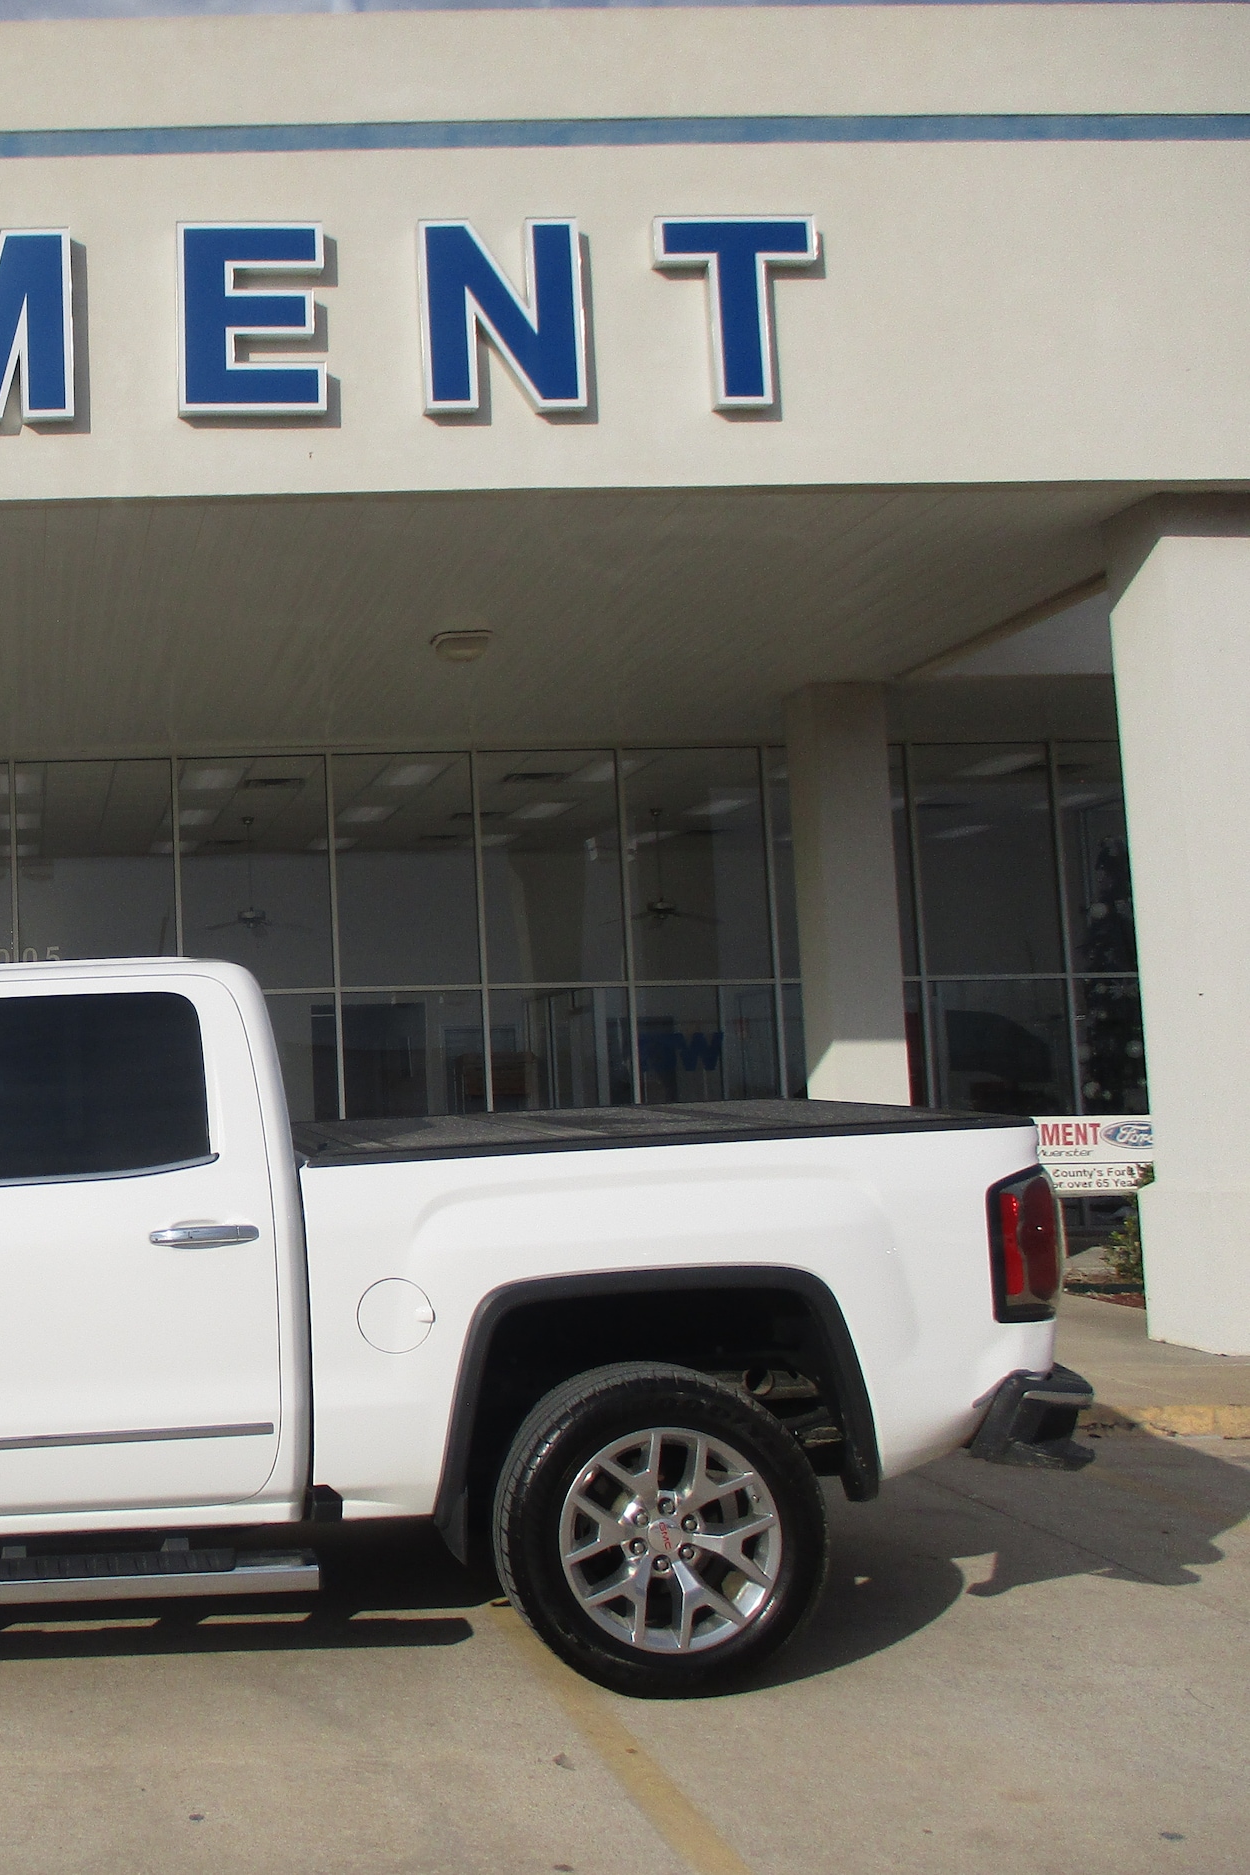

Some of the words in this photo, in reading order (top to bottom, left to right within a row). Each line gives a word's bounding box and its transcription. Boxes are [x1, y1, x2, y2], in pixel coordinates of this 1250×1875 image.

[1037, 1122, 1101, 1146] MENT
[1052, 1167, 1104, 1179] County's
[1067, 1180, 1093, 1189] over
[1095, 1179, 1110, 1188] 65
[659, 1521, 672, 1550] GMC
